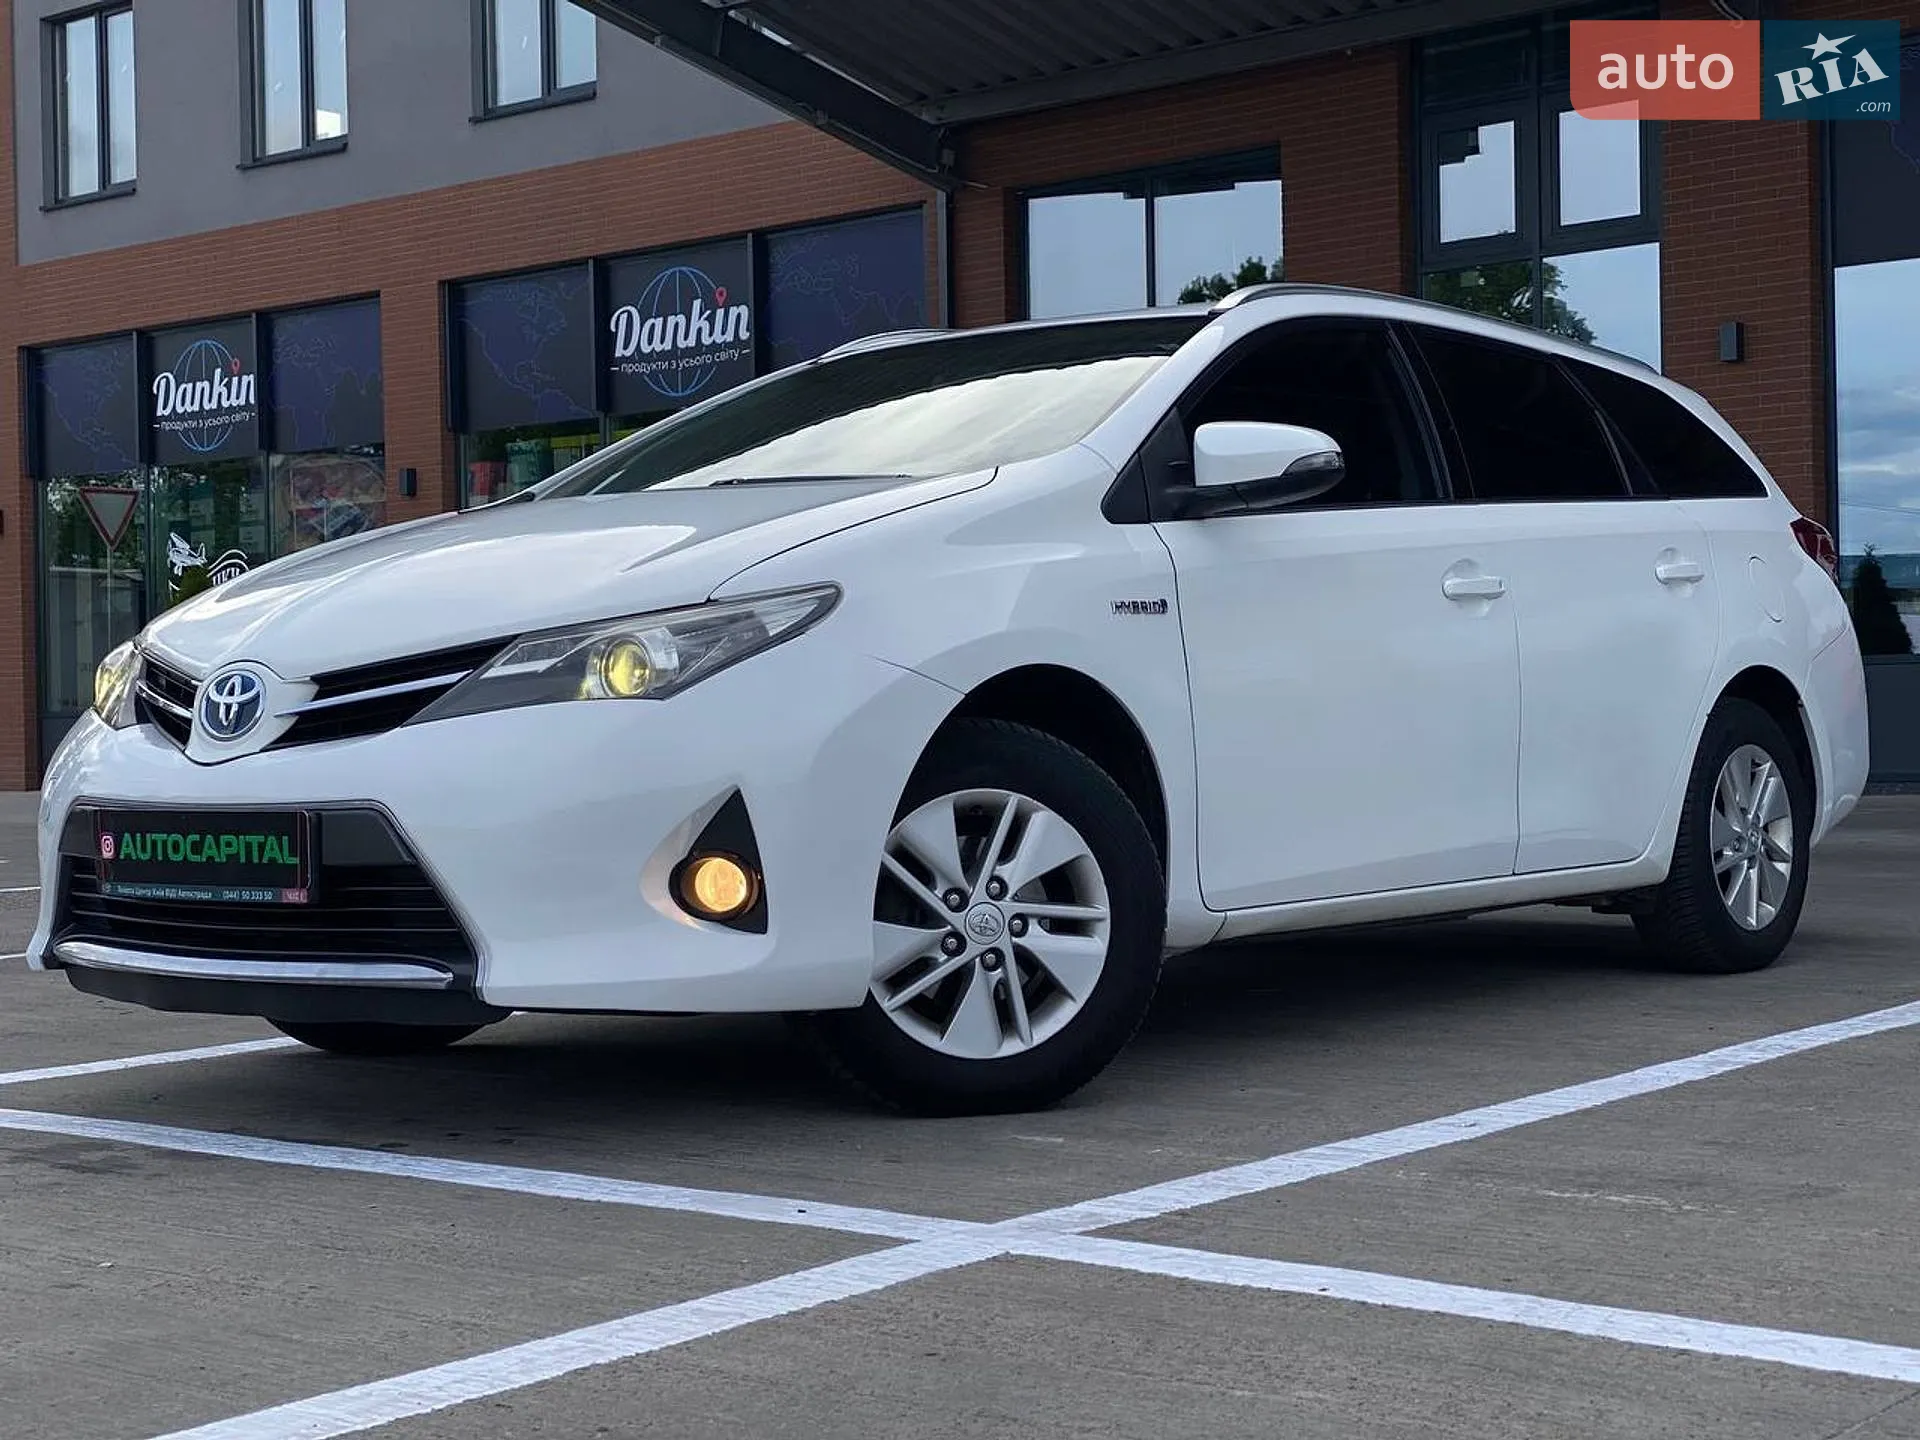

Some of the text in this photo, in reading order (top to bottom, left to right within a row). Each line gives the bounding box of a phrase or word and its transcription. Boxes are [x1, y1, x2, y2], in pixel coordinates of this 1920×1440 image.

[610, 298, 750, 358] Dankin
[621, 347, 740, 374] продукти з усього світу
[152, 367, 255, 417] Dankin
[1110, 599, 1161, 614] HYBRID
[119, 832, 299, 864] AUTOCAPITAL
